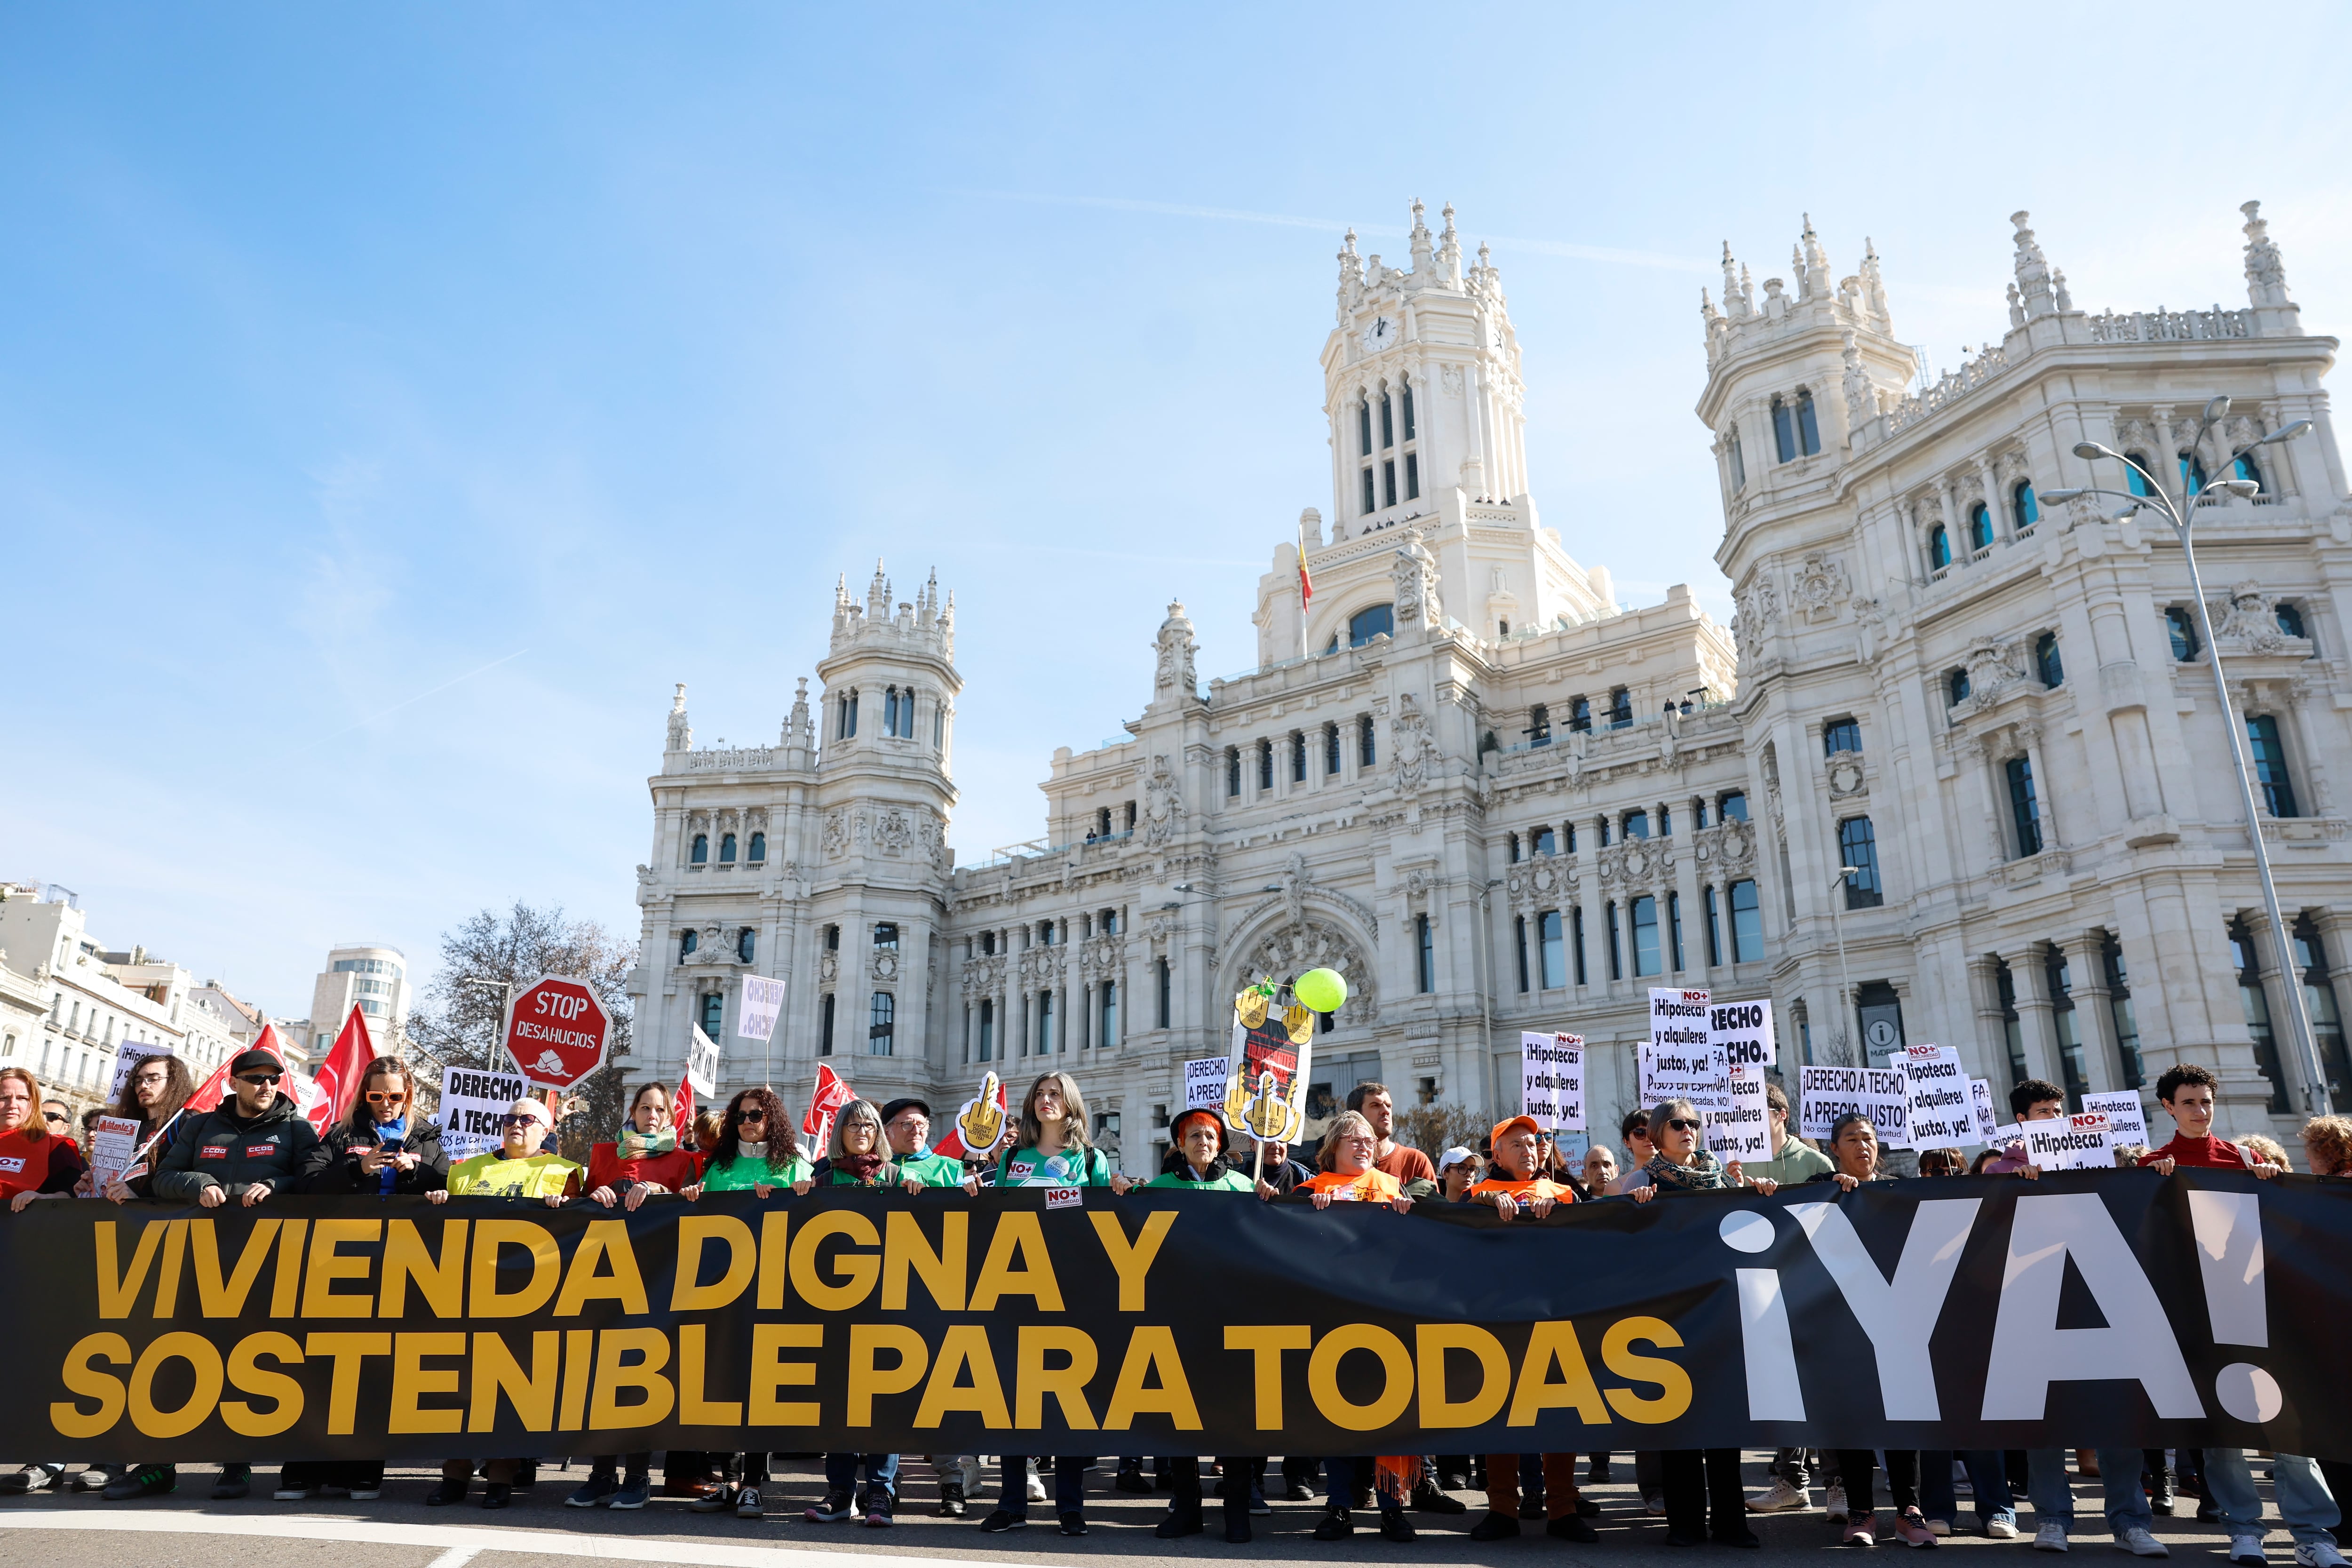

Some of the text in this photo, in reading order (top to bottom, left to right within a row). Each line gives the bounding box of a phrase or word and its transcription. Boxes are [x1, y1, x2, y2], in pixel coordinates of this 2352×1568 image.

[535, 991, 588, 1021] STOP
[1684, 992, 1708, 1000] NO+
[1241, 1013, 1262, 1023] SOSTENIBLE
[1245, 1007, 1261, 1016] VIVIENDA
[516, 1021, 596, 1049] DESAHUCIOS
[1558, 1034, 1581, 1043] NO+
[1656, 1026, 1707, 1046] y alquileres
[1527, 1043, 1578, 1064] ¡Hipotecas
[1908, 1046, 1935, 1055] NO+
[117, 1069, 123, 1079] y
[703, 1050, 715, 1085] YA!
[1187, 1059, 1225, 1082] ¡DERECHO
[1657, 1053, 1689, 1073] justos,
[1692, 1054, 1708, 1075] ya!
[449, 1072, 522, 1102] DERECHO
[1527, 1071, 1578, 1092] y alquileres
[1804, 1069, 1906, 1099] ¡DERECHO A TECHO,
[1189, 1086, 1195, 1102] A
[1717, 1096, 1729, 1106] NO!
[1915, 1088, 1963, 1110] alquileres
[447, 1108, 459, 1131] A
[1527, 1098, 1579, 1121] justos, ya!
[1706, 1105, 1762, 1129] y alquileres
[1804, 1101, 1812, 1122] A
[973, 1122, 992, 1131] VIVIENDA
[1912, 1114, 1971, 1141] justos, ya!
[1983, 1126, 1995, 1136] NO!
[2072, 1115, 2106, 1127] NO+
[968, 1130, 993, 1139] SOSTENIBLE
[1746, 1132, 1764, 1154] ya!
[2030, 1132, 2103, 1155] ¡Hipotecas
[94, 1154, 104, 1167] LAS
[103, 1156, 125, 1171] CALLES
[102, 1146, 111, 1157] QUE
[111, 1148, 129, 1159] TOMAR
[1046, 1164, 1062, 1175] guerra
[1048, 1190, 1078, 1202] NO+
[95, 1210, 1178, 1318] VIVIENDA DIGNA Y
[1719, 1190, 2282, 1423] ¡YA!
[50, 1316, 1692, 1438] SOSTENIBLE PARA TODAS
